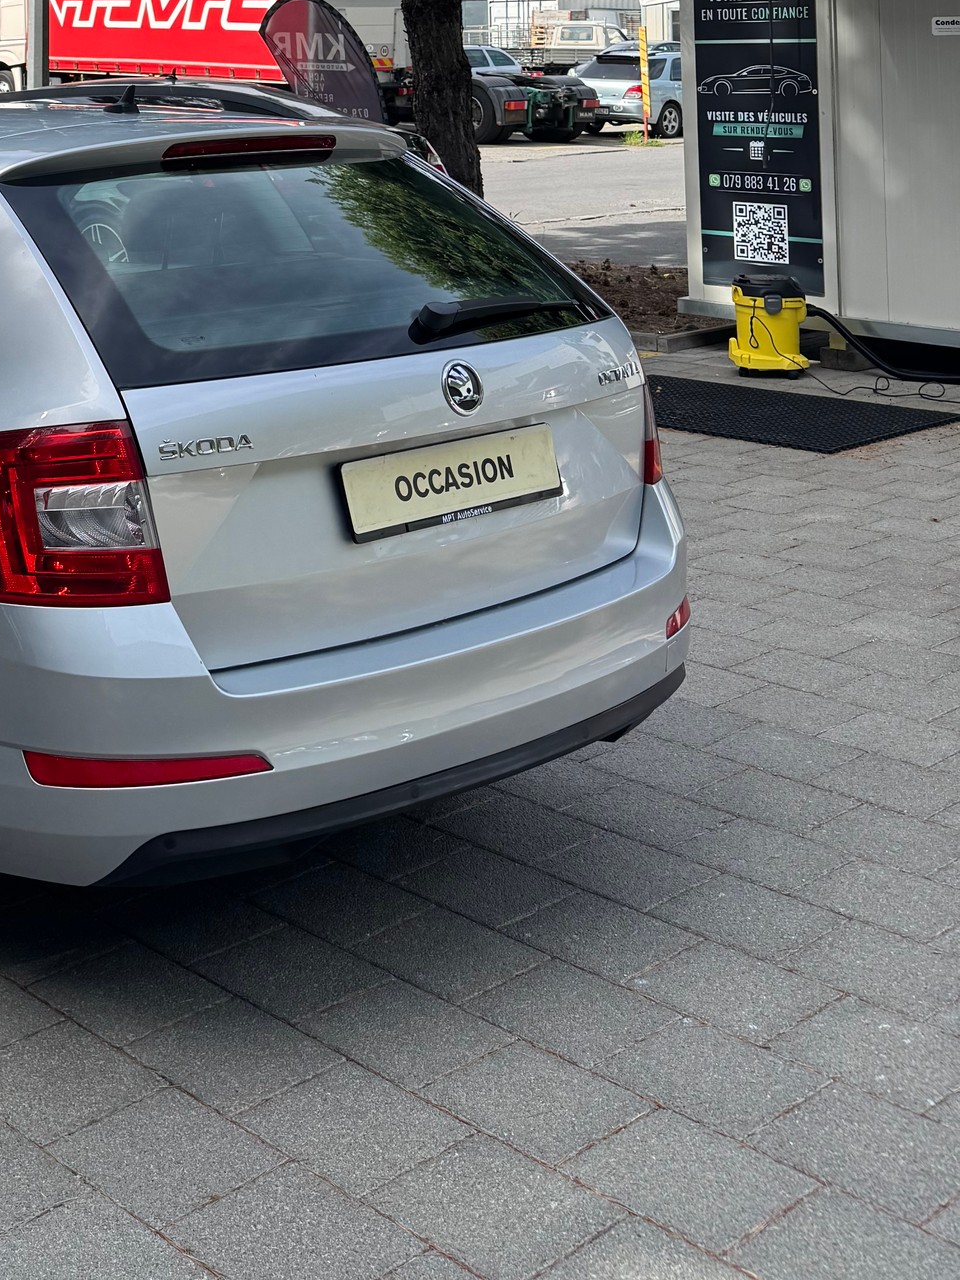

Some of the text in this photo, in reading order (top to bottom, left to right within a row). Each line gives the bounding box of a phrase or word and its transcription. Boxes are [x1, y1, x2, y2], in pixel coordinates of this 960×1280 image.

[702, 10, 712, 20] EN
[717, 8, 747, 20] TOUTE
[707, 109, 808, 123] VISITE DES VÉHICULES
[722, 126, 794, 136] SUR RENDE-VOUS
[723, 174, 796, 191] 079 883 41 26
[158, 433, 254, 460] ŠKODA
[394, 454, 515, 501] OCCASION
[442, 505, 492, 523] MPT AutoService
